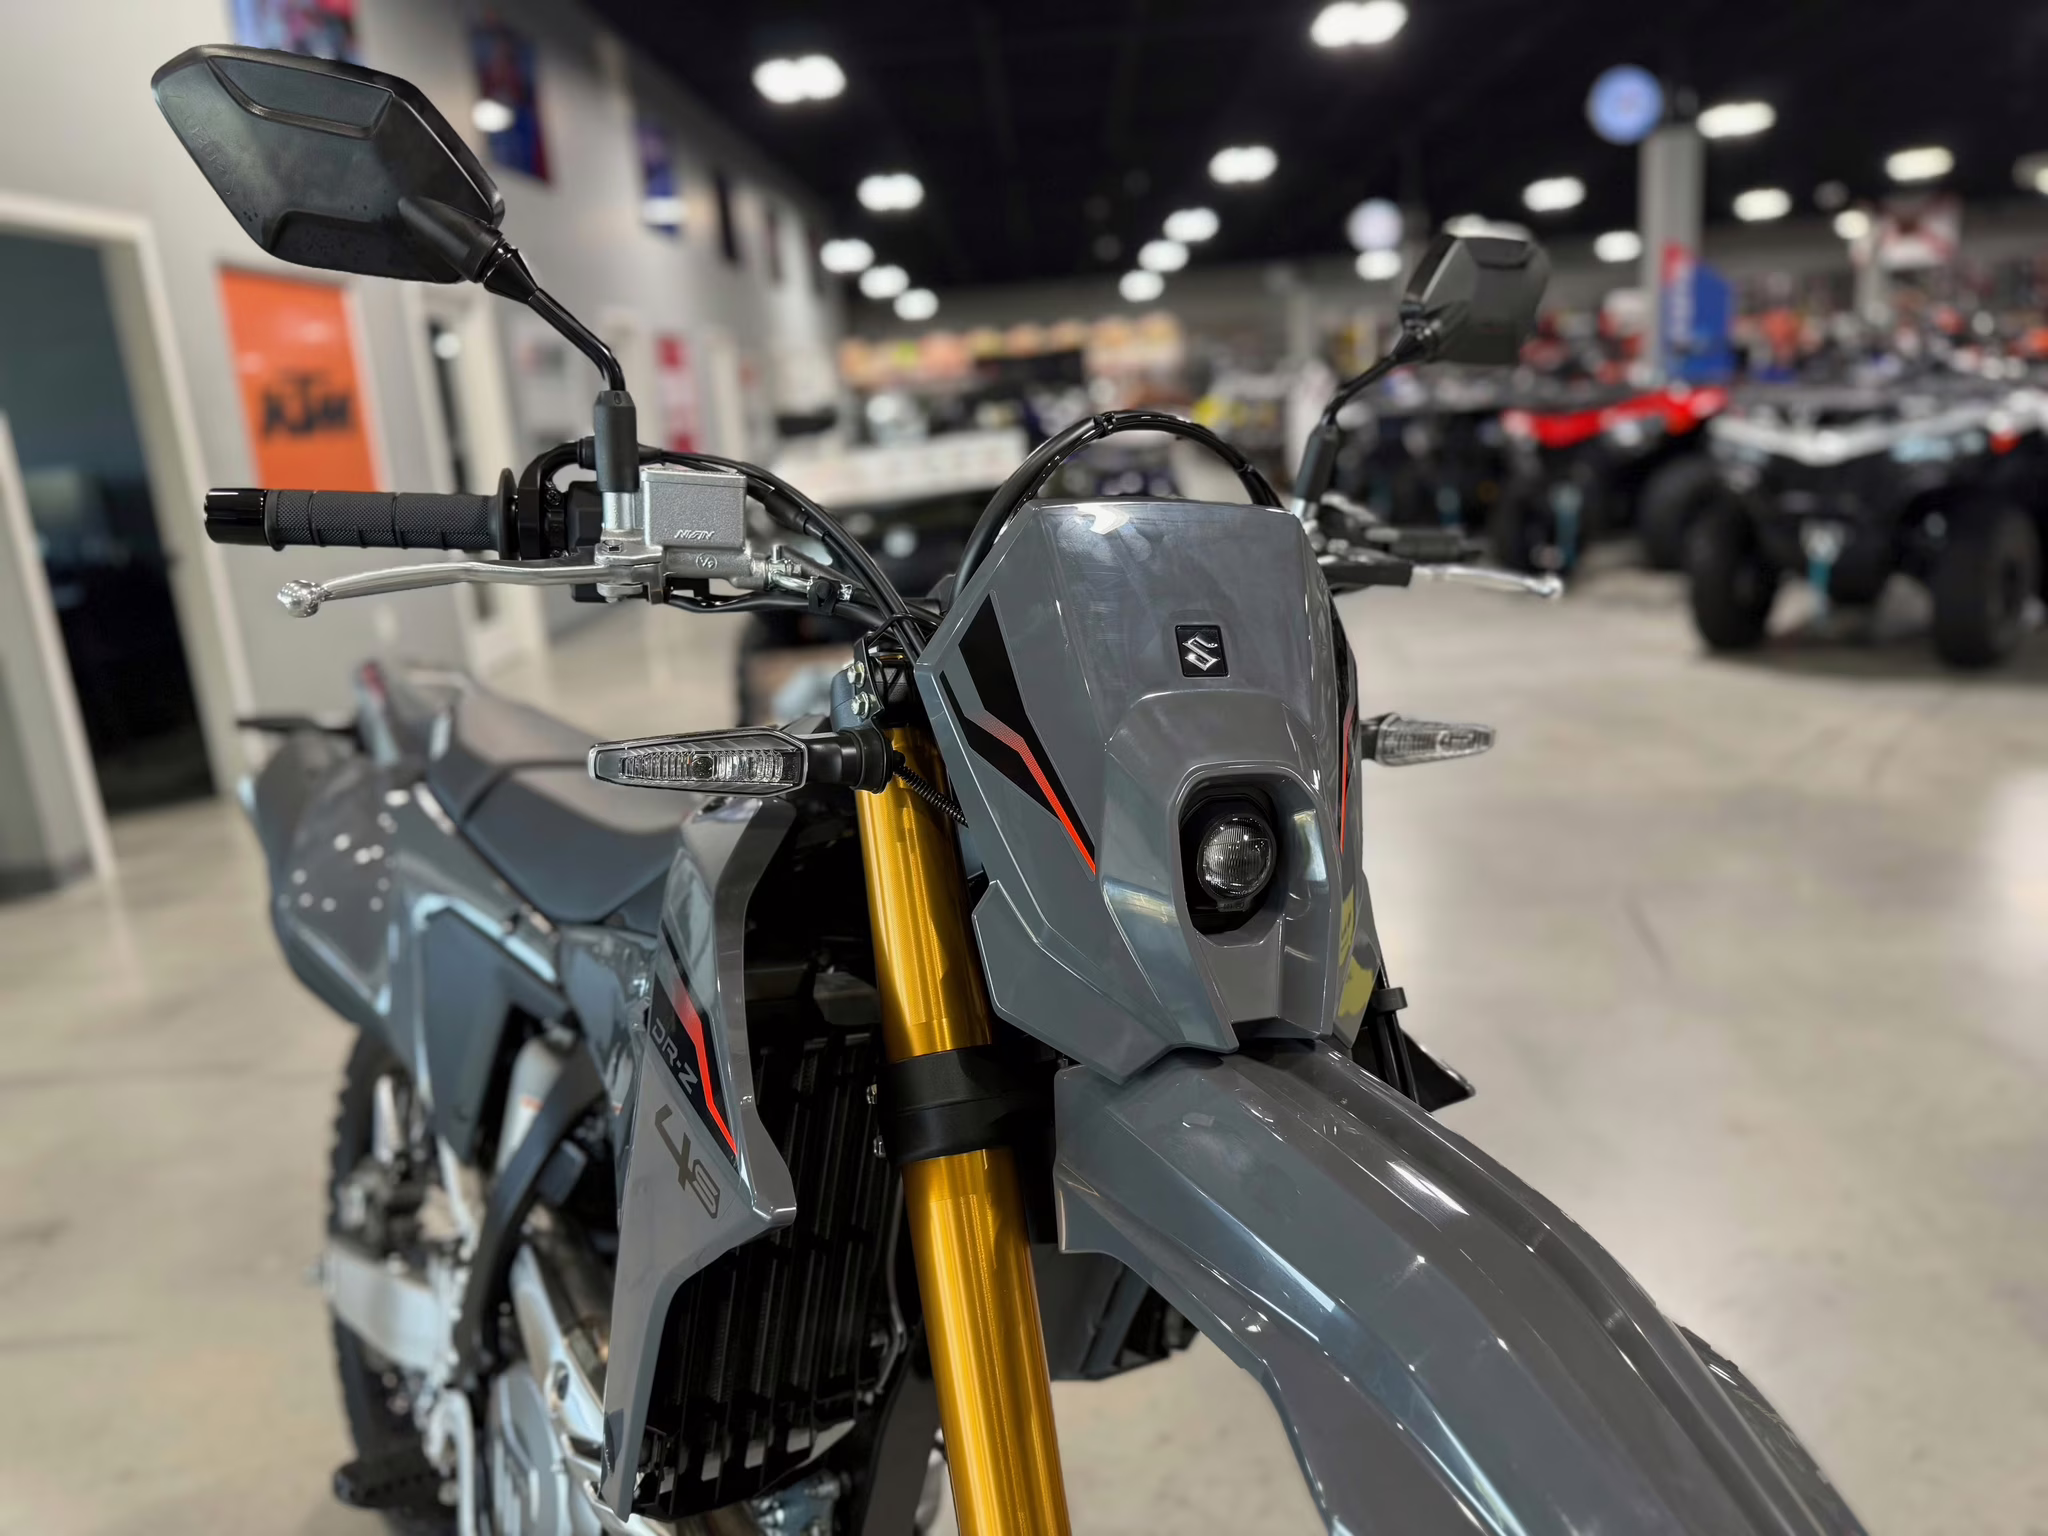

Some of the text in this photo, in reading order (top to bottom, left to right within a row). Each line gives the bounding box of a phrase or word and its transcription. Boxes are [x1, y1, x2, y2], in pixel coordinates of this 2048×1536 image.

[259, 371, 355, 443] KTM
[652, 1017, 698, 1095] DR-Z
[655, 1103, 721, 1219] 4S
